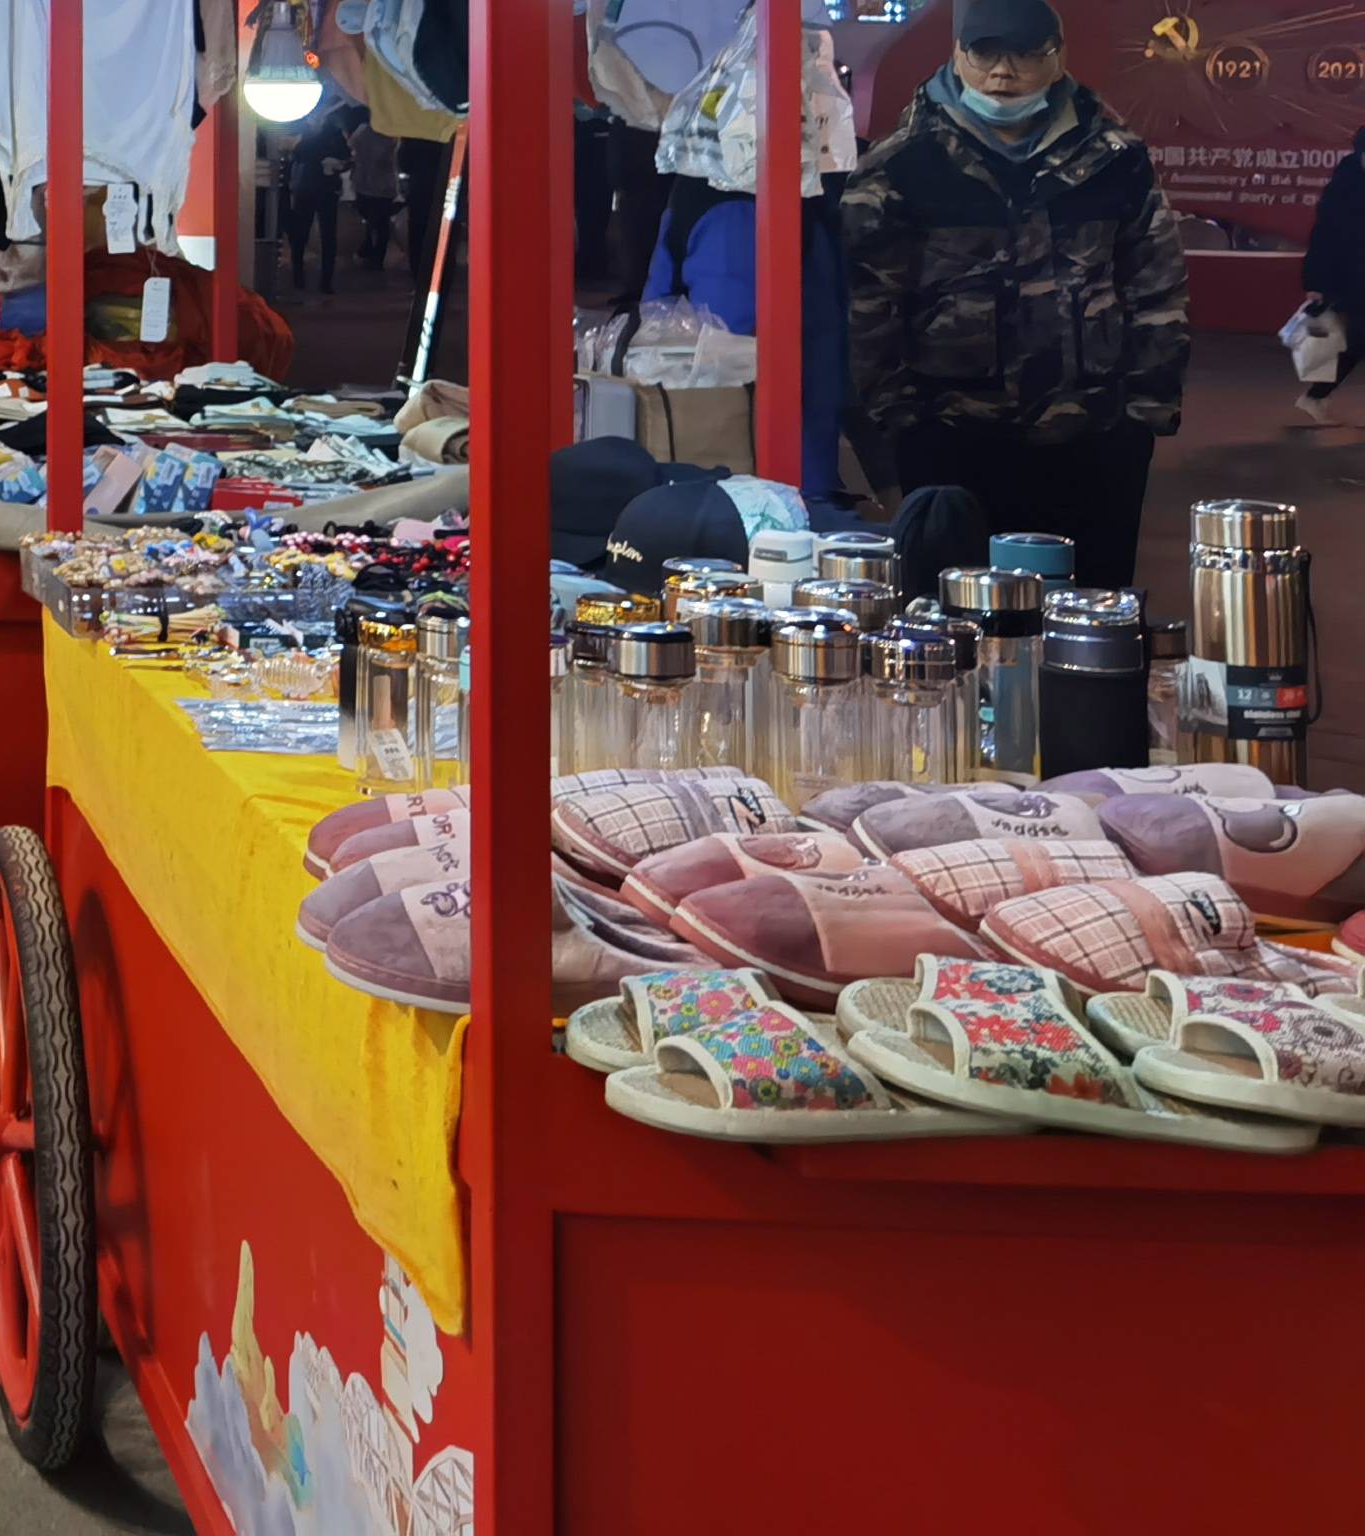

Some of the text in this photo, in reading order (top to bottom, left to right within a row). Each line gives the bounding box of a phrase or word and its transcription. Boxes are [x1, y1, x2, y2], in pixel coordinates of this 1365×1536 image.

[1217, 61, 1365, 80] 1921 2021
[1148, 146, 1352, 170] 中国共产党成立100
